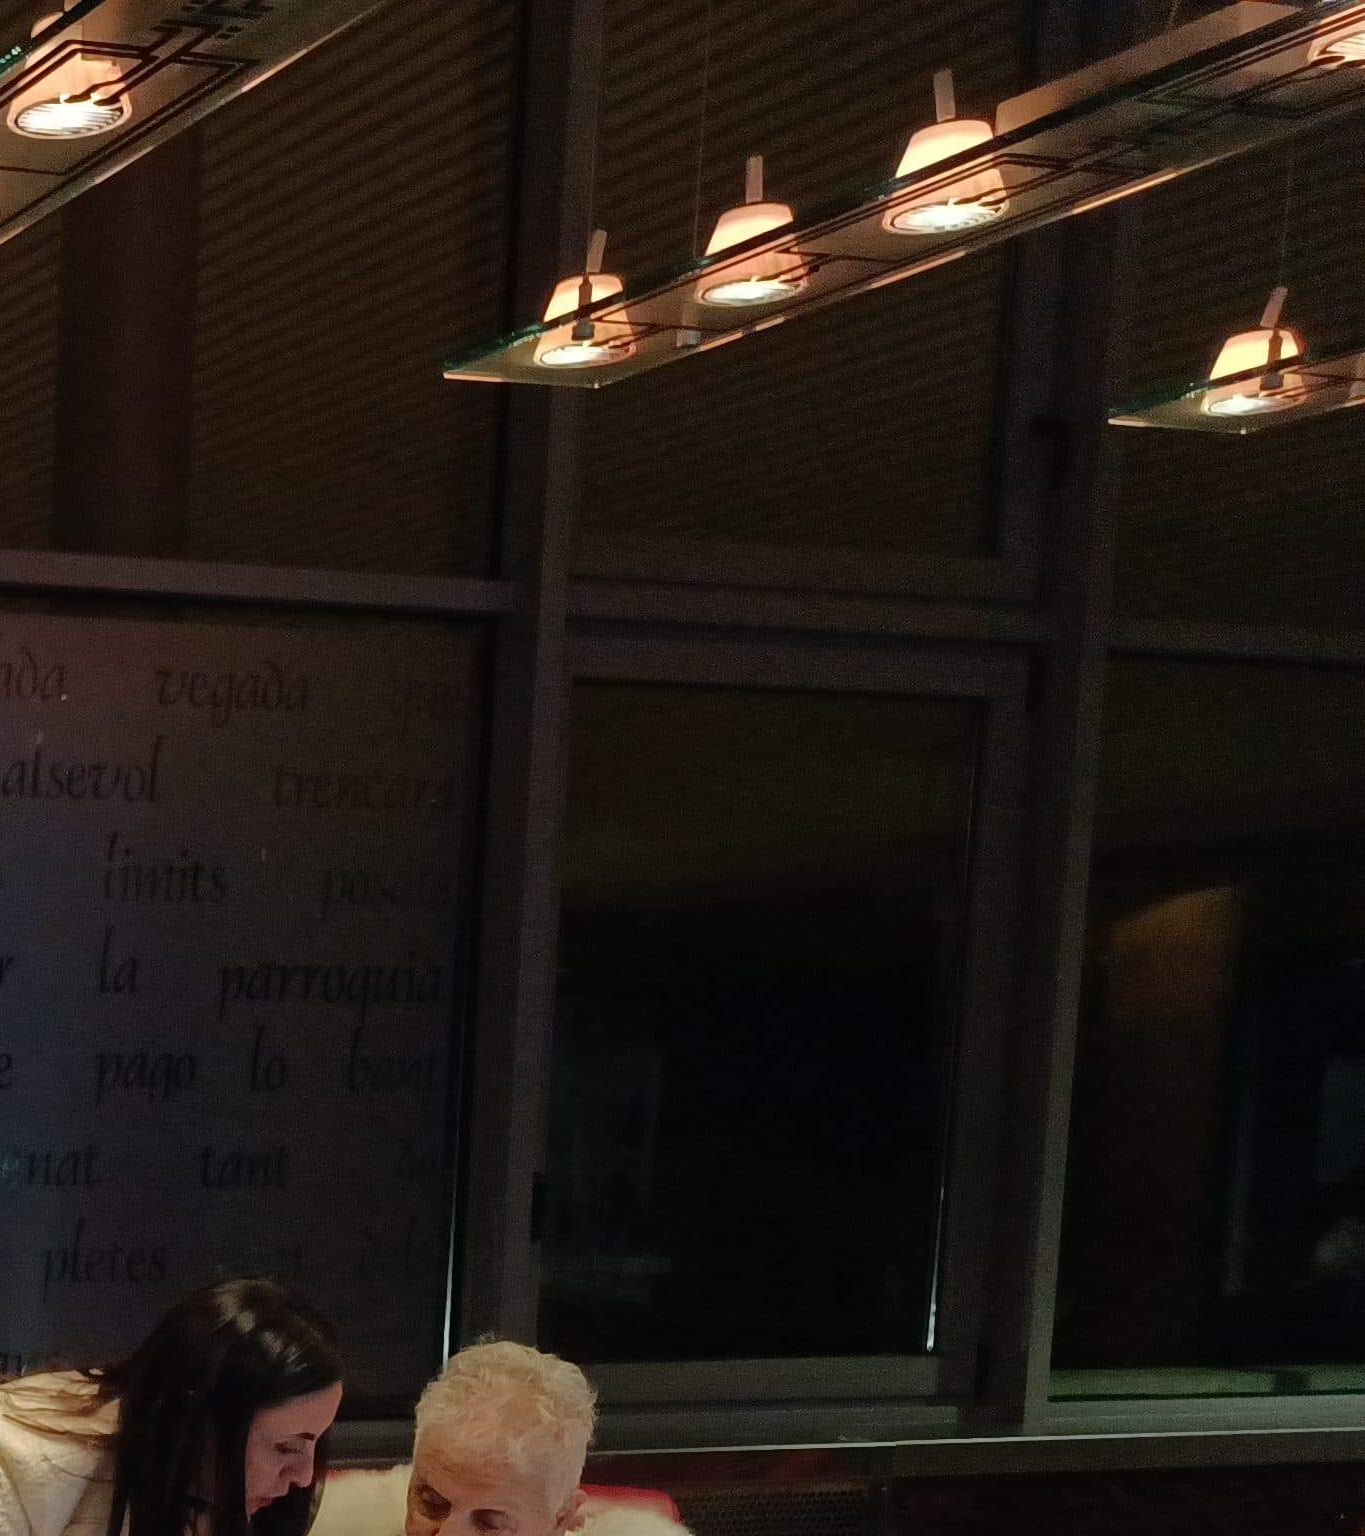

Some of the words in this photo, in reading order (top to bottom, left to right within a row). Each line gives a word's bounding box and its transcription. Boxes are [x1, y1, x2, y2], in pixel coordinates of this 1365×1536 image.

[103, 832, 230, 905] limits
[96, 925, 141, 996] la
[250, 1025, 289, 1092] lo
